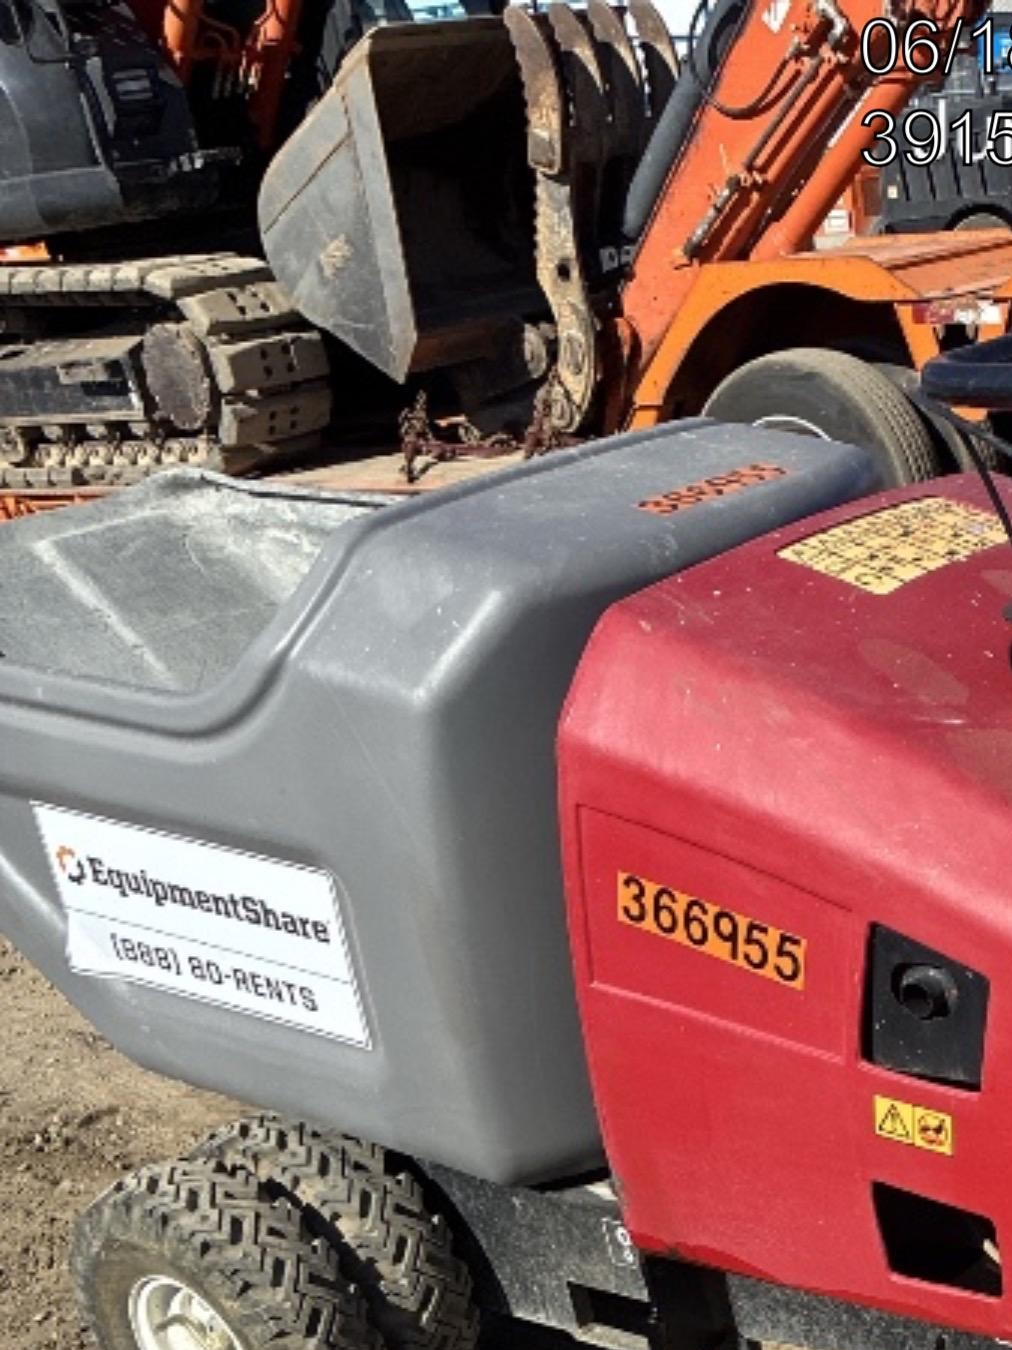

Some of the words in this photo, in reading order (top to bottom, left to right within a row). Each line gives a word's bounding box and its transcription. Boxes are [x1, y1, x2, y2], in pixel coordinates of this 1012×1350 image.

[86, 855, 332, 944] EquipmentShare
[621, 874, 802, 983] 366955
[110, 932, 182, 976] (888)
[187, 955, 320, 1012] 80-RENTS
